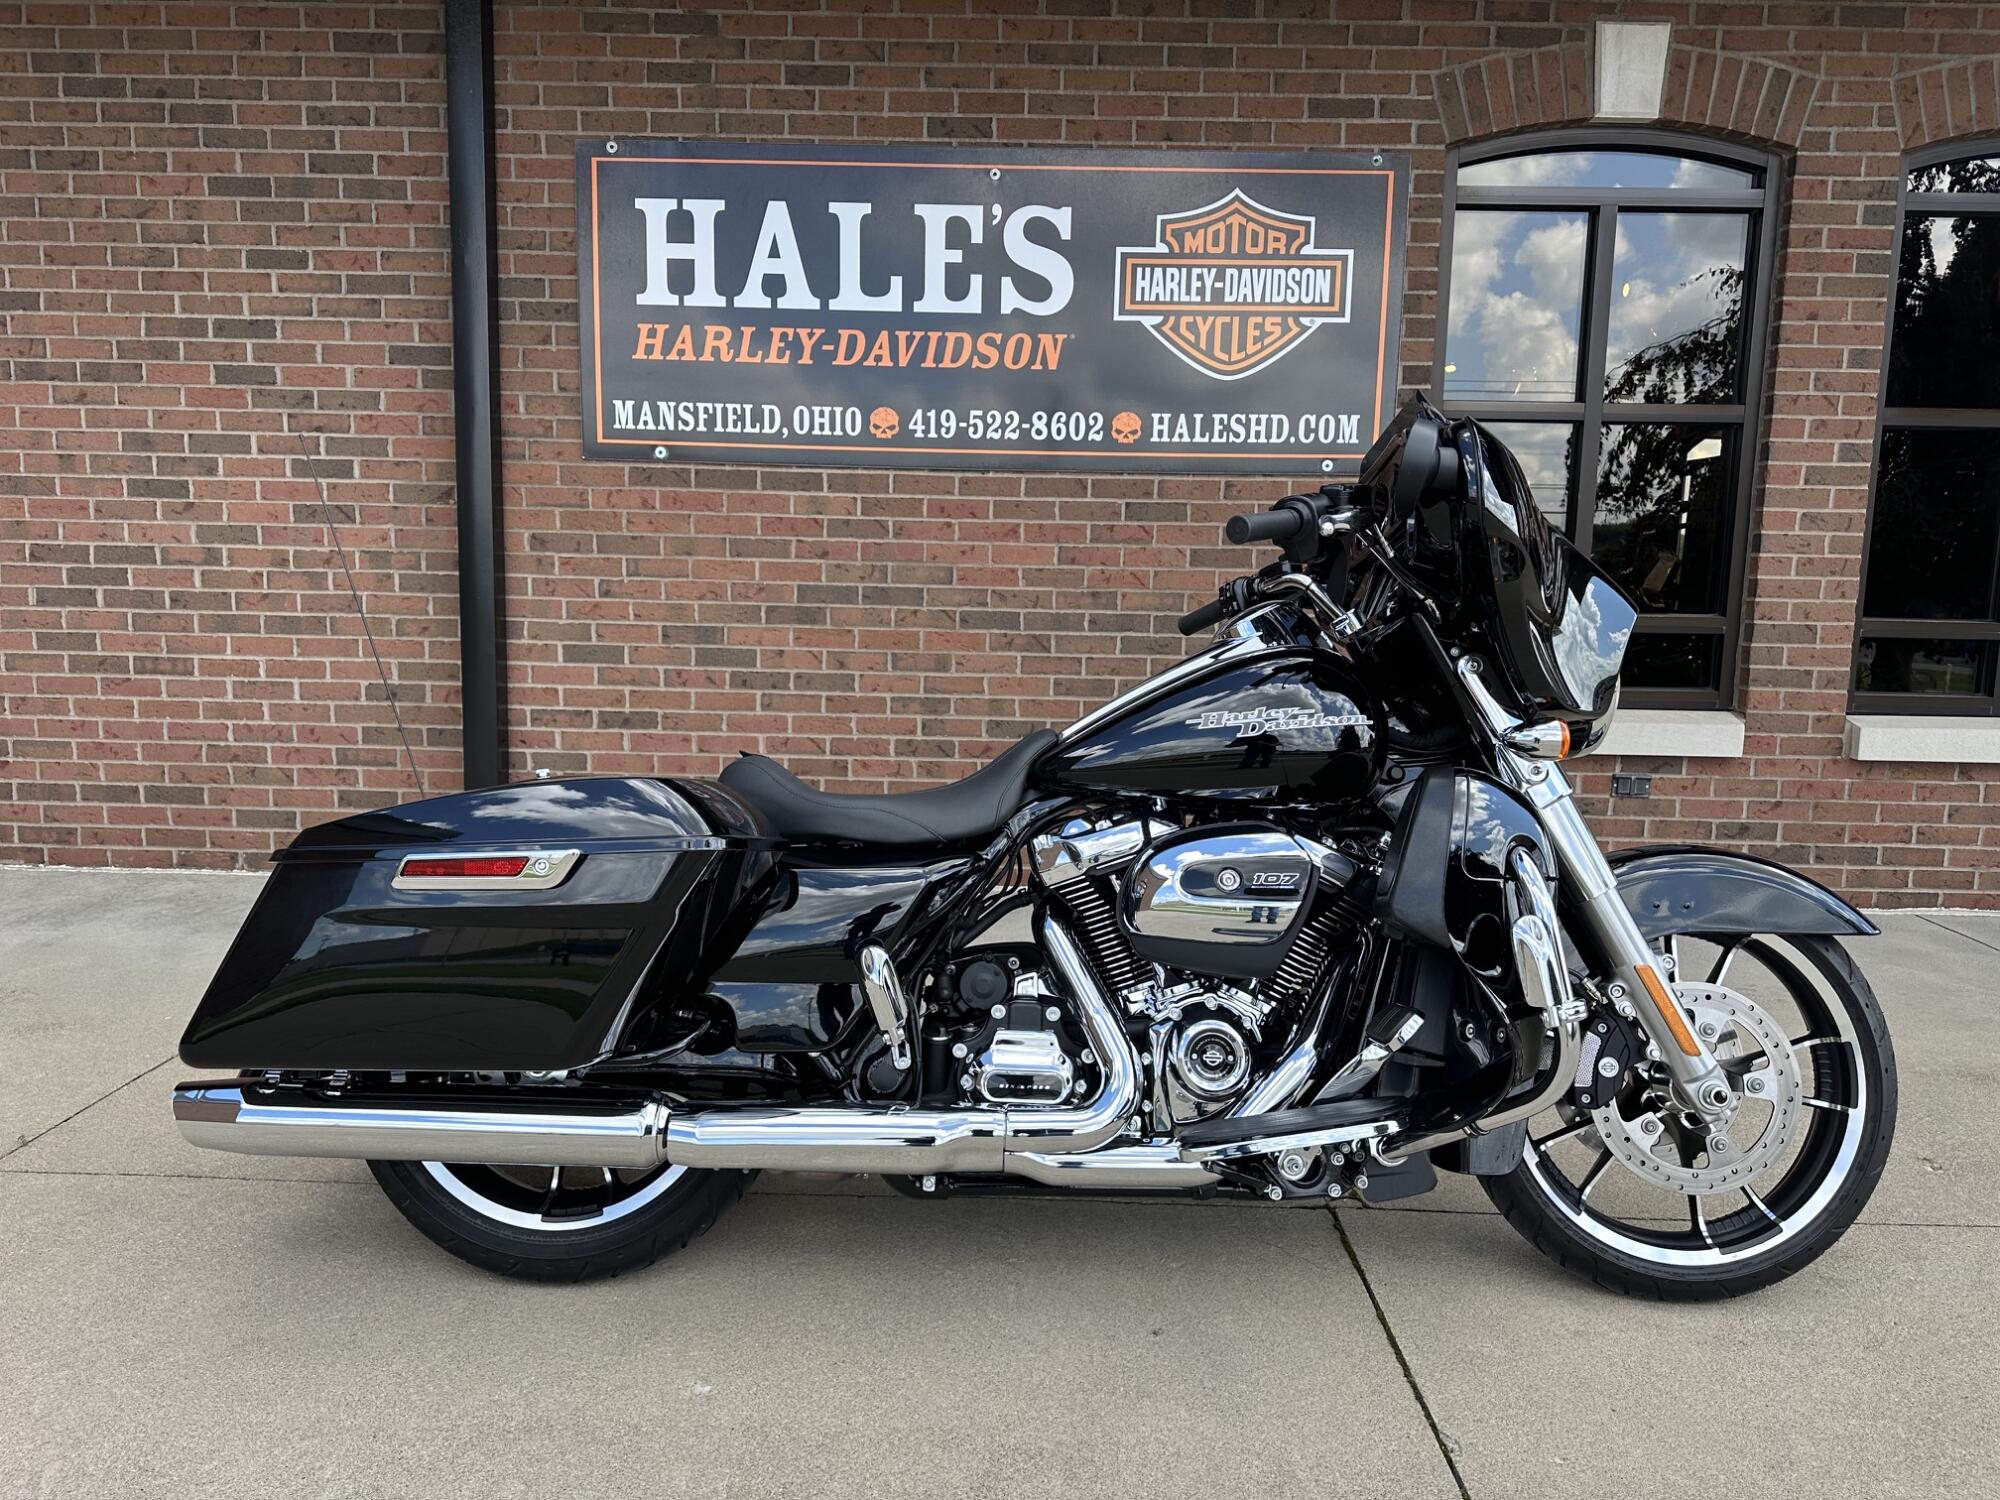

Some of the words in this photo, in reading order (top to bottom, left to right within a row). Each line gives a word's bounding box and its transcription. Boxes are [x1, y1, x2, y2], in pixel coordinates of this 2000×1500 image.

[1183, 212, 1287, 255] MOTOR
[635, 197, 1074, 316] HALE'S
[1135, 266, 1332, 305] HARLEY-DAVIDSON
[631, 323, 1068, 371] HARLEY-DAVIDSON
[1179, 315, 1283, 363] CYCLES
[908, 408, 1104, 442] 419-522-8602
[1150, 412, 1361, 444] HALESHD.COM
[1186, 706, 1315, 729] Harley
[1228, 713, 1373, 737] Davidson
[1252, 872, 1300, 885] 107
